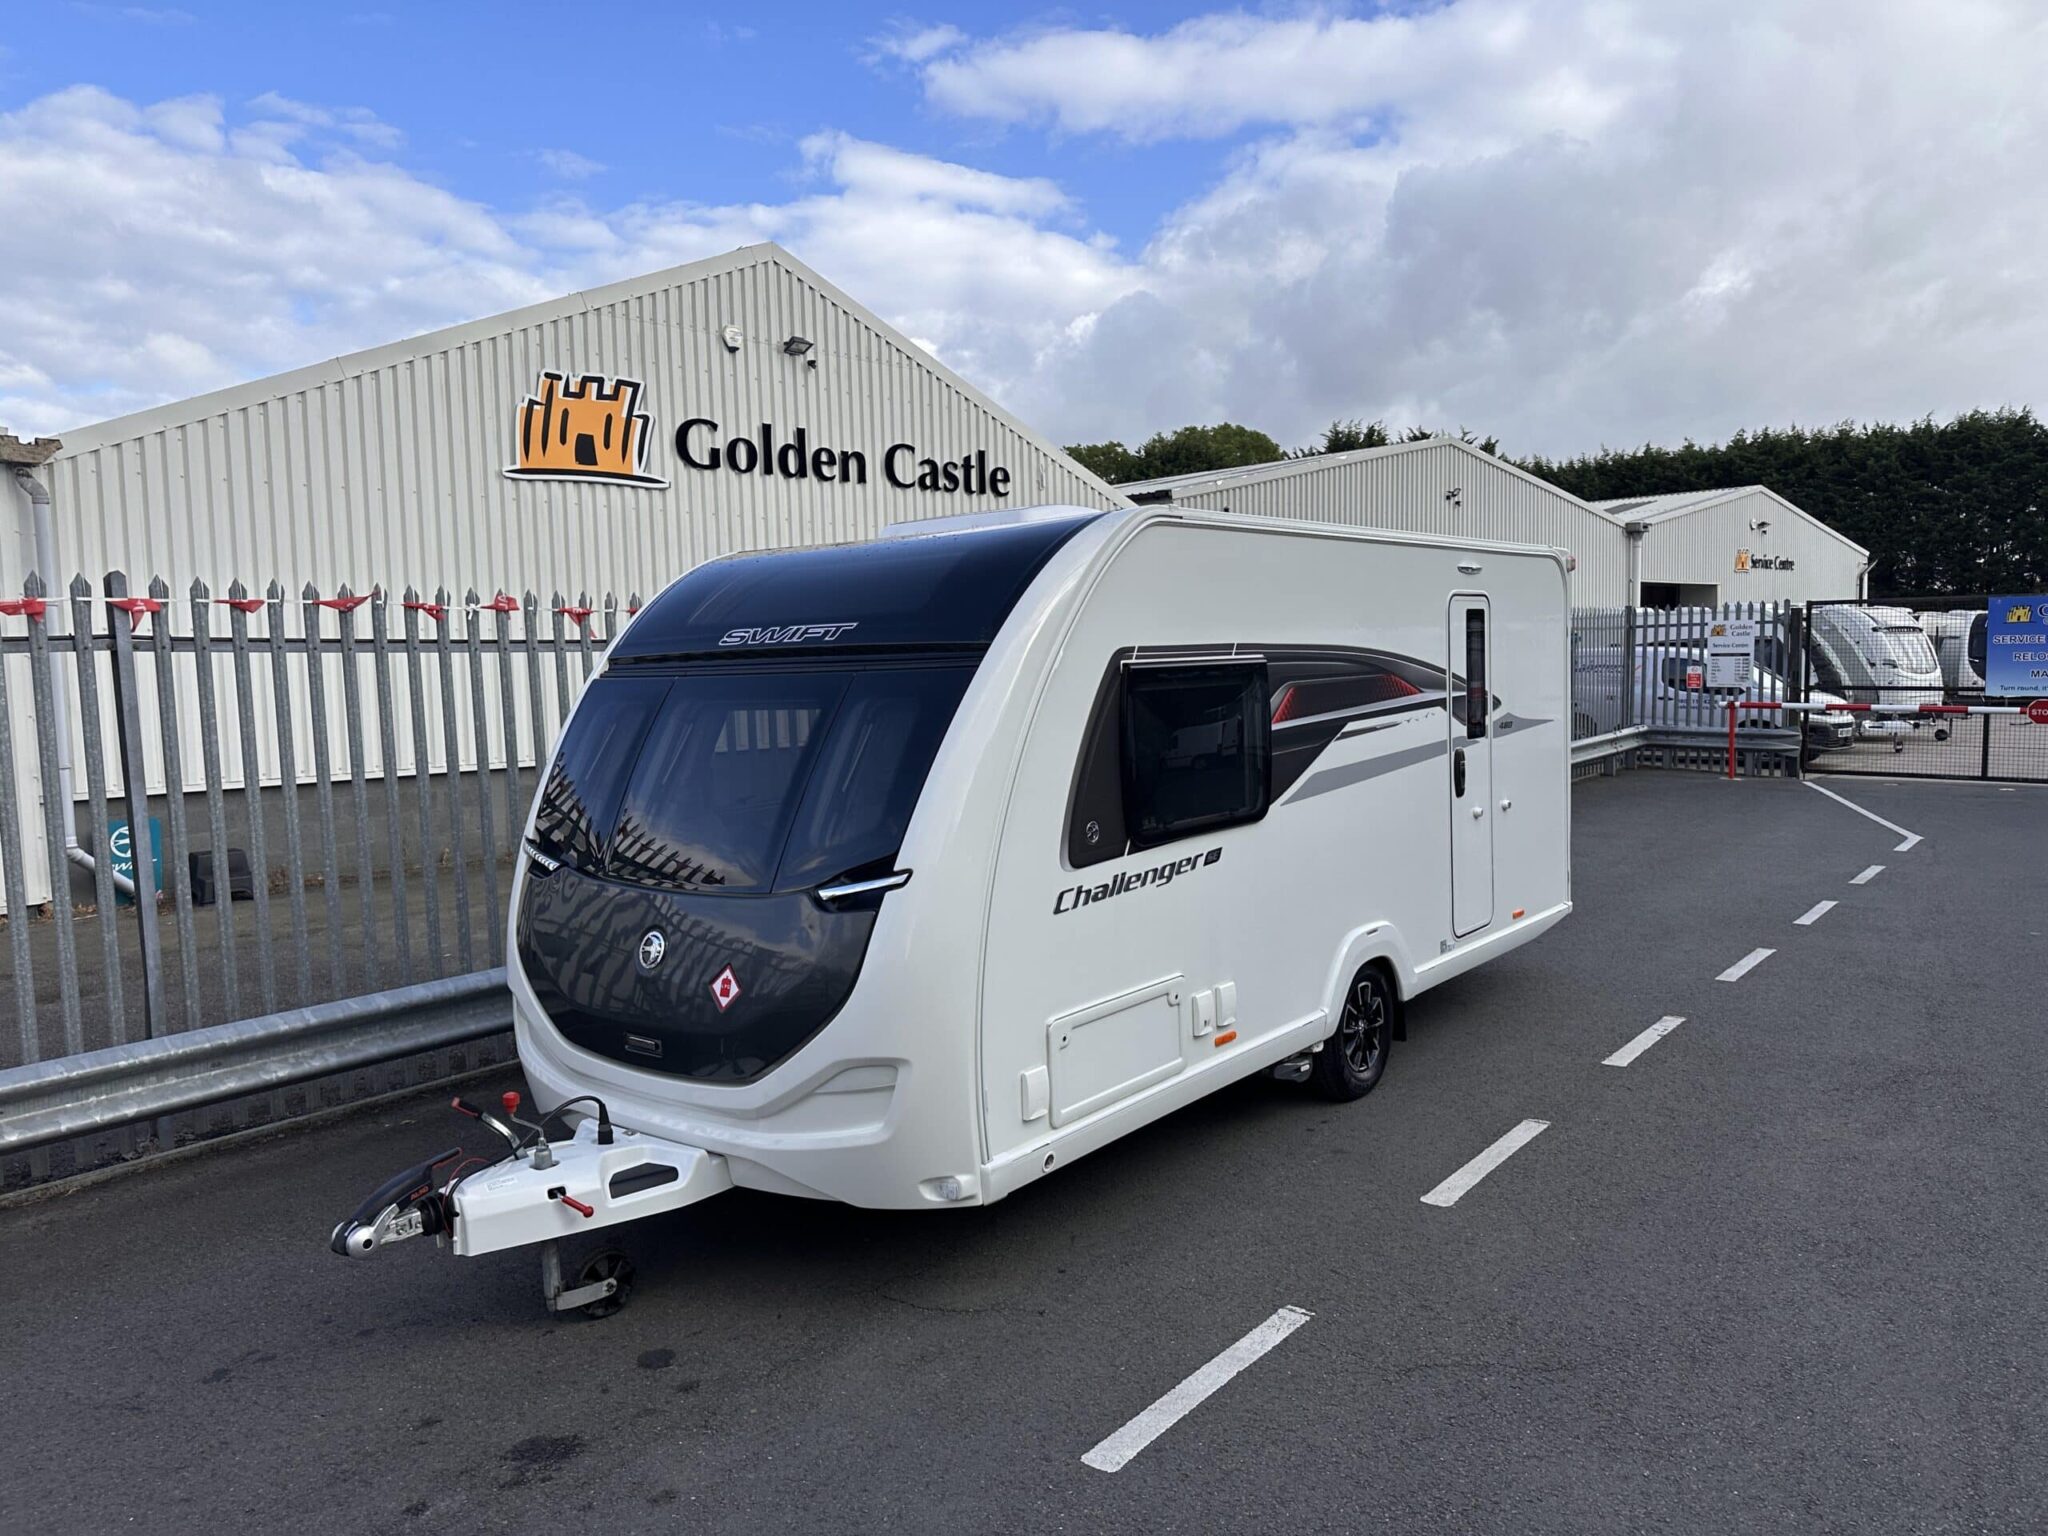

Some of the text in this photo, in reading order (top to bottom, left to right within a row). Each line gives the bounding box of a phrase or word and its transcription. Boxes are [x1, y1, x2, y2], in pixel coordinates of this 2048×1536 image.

[675, 417, 1011, 498] Golden Castle
[1750, 553, 1795, 571] Service Centre
[718, 622, 859, 646] SWIFT
[1993, 635, 2046, 644] SERVICE
[2013, 652, 2048, 661] RELO
[2000, 684, 2016, 692] Turn
[1052, 852, 1204, 916] Challenger
